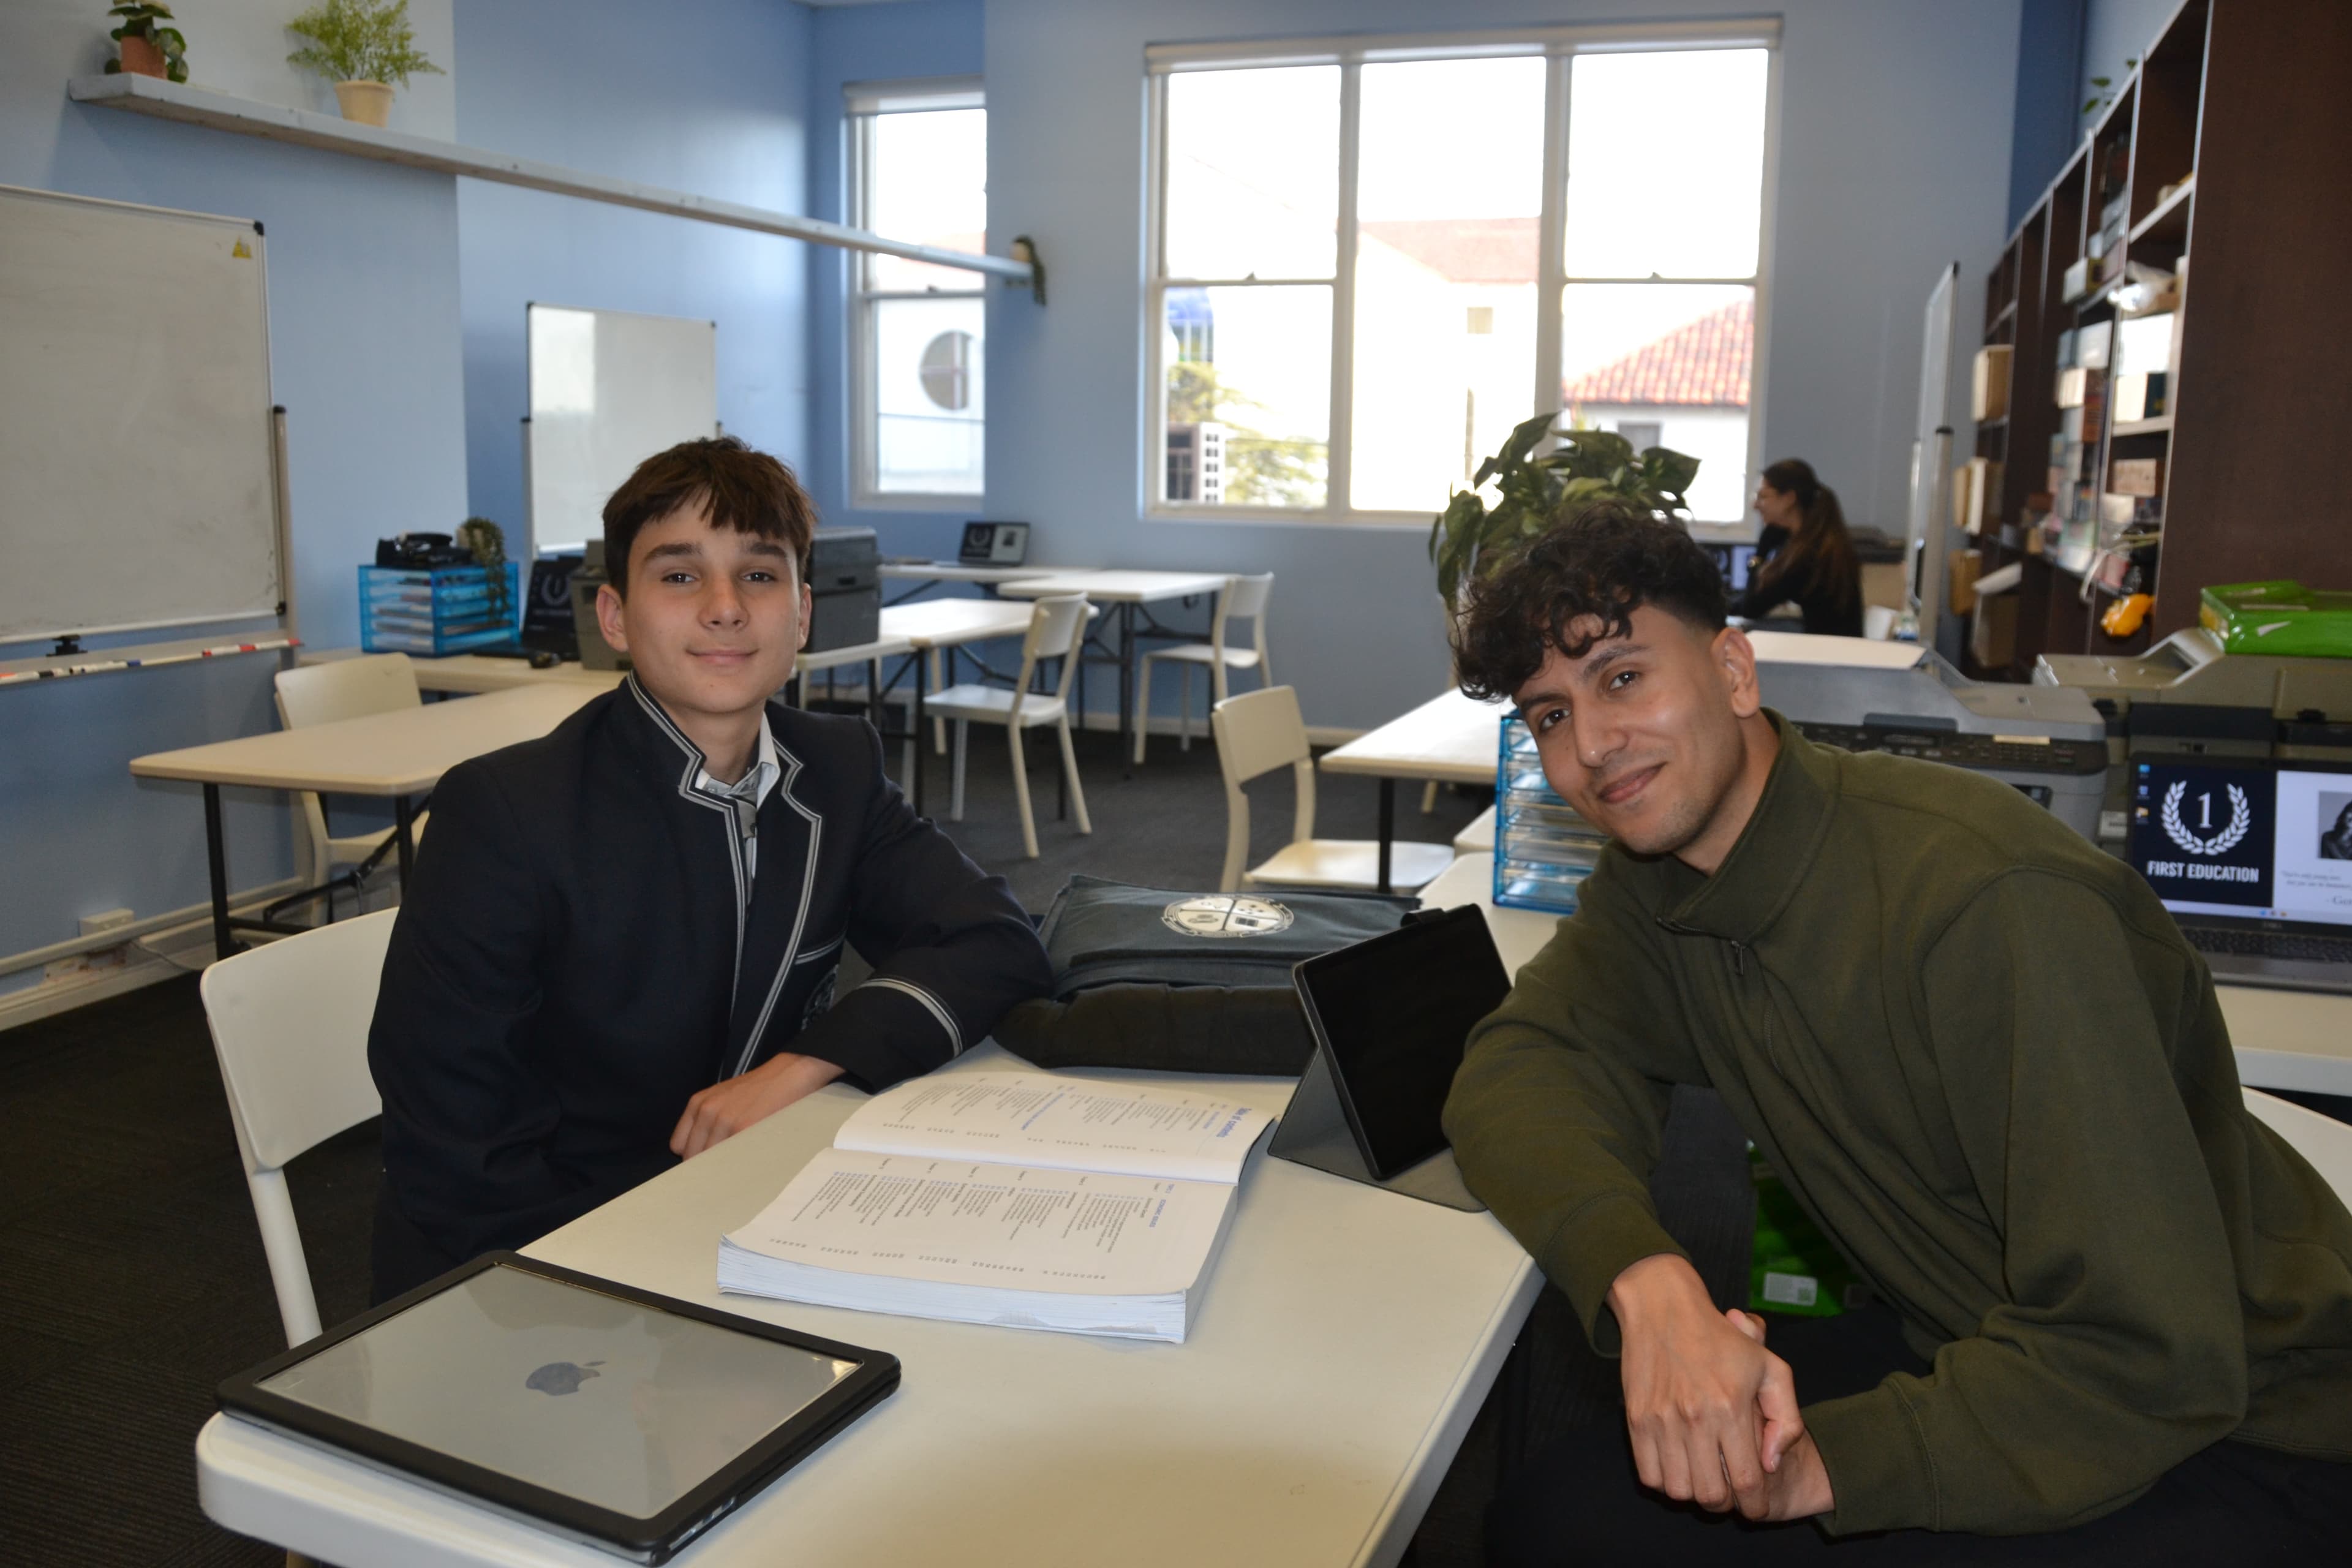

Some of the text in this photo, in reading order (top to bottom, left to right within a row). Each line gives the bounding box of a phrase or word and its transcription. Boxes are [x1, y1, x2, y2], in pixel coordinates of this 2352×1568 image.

[2198, 792, 2213, 828] 1
[2146, 860, 2185, 878] FIRST
[2186, 863, 2260, 883] EDUCATION
